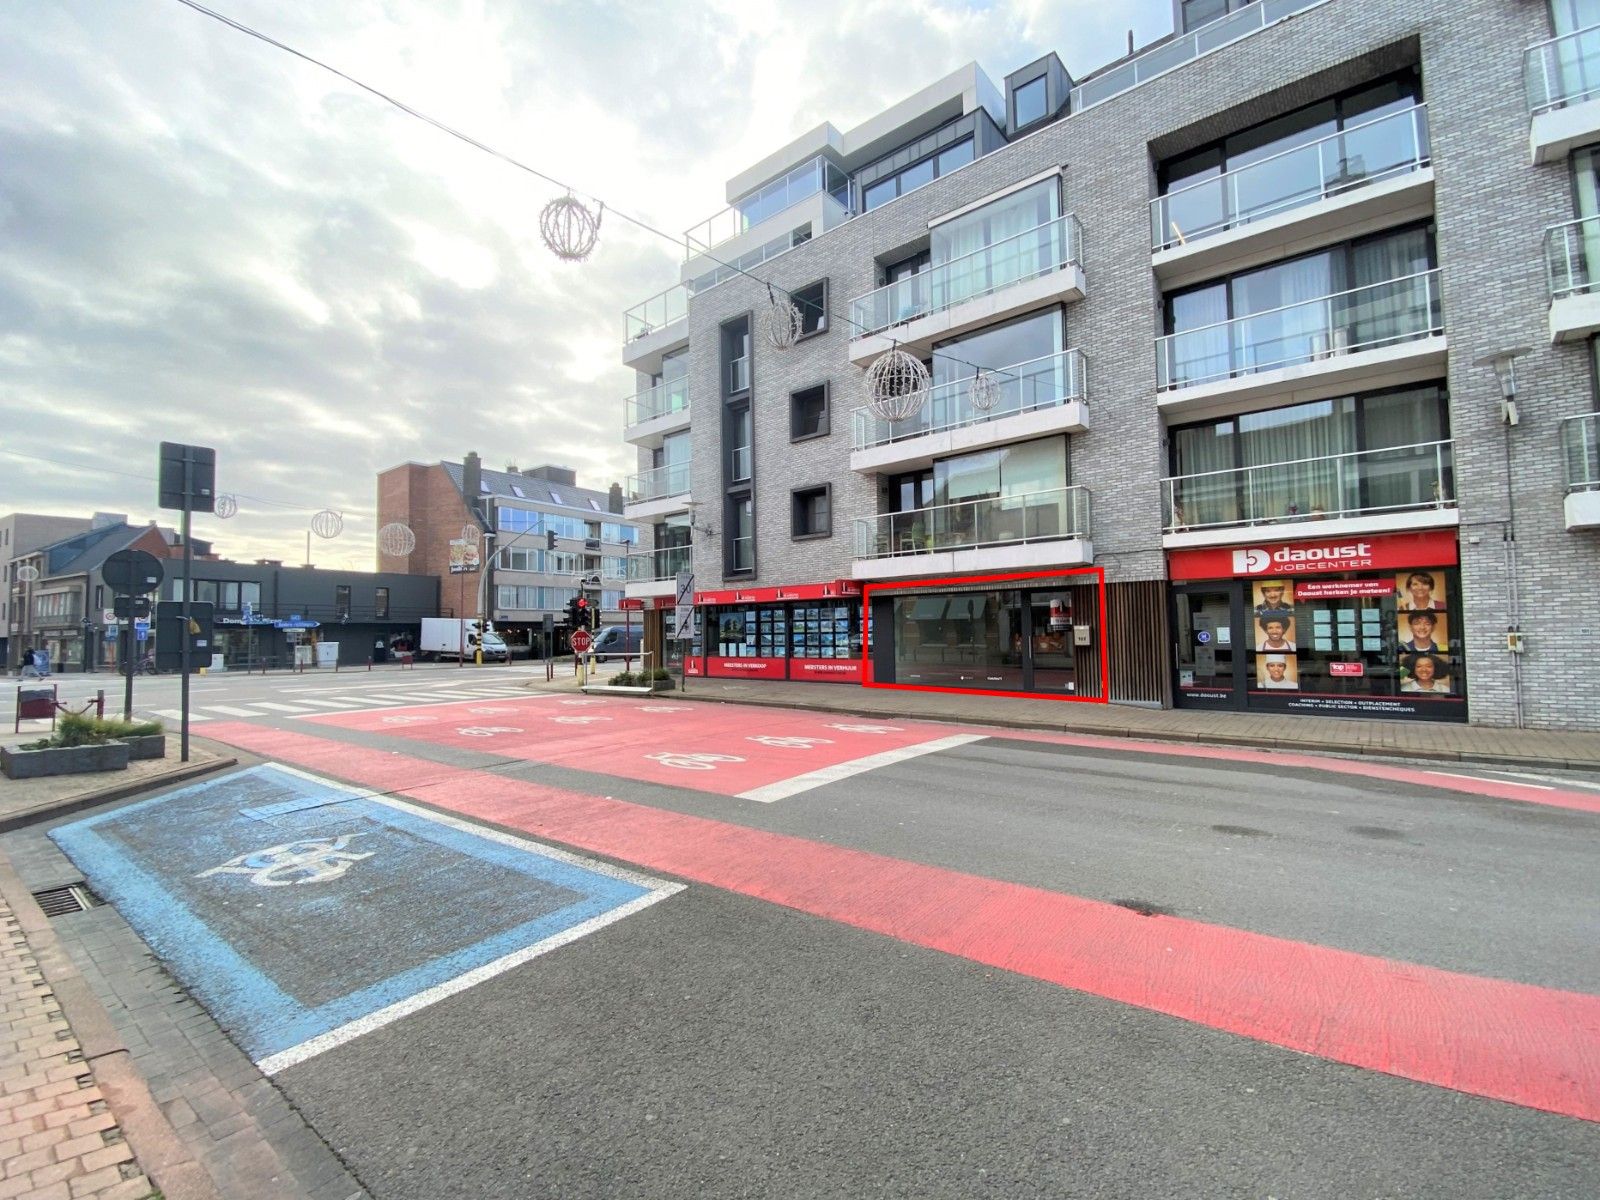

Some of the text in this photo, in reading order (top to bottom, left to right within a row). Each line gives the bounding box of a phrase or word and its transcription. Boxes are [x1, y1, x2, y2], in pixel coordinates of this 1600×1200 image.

[1274, 543, 1372, 562] daoust
[1274, 560, 1372, 572] JOBCENTER
[680, 584, 691, 593] 30
[572, 638, 590, 646] STOP
